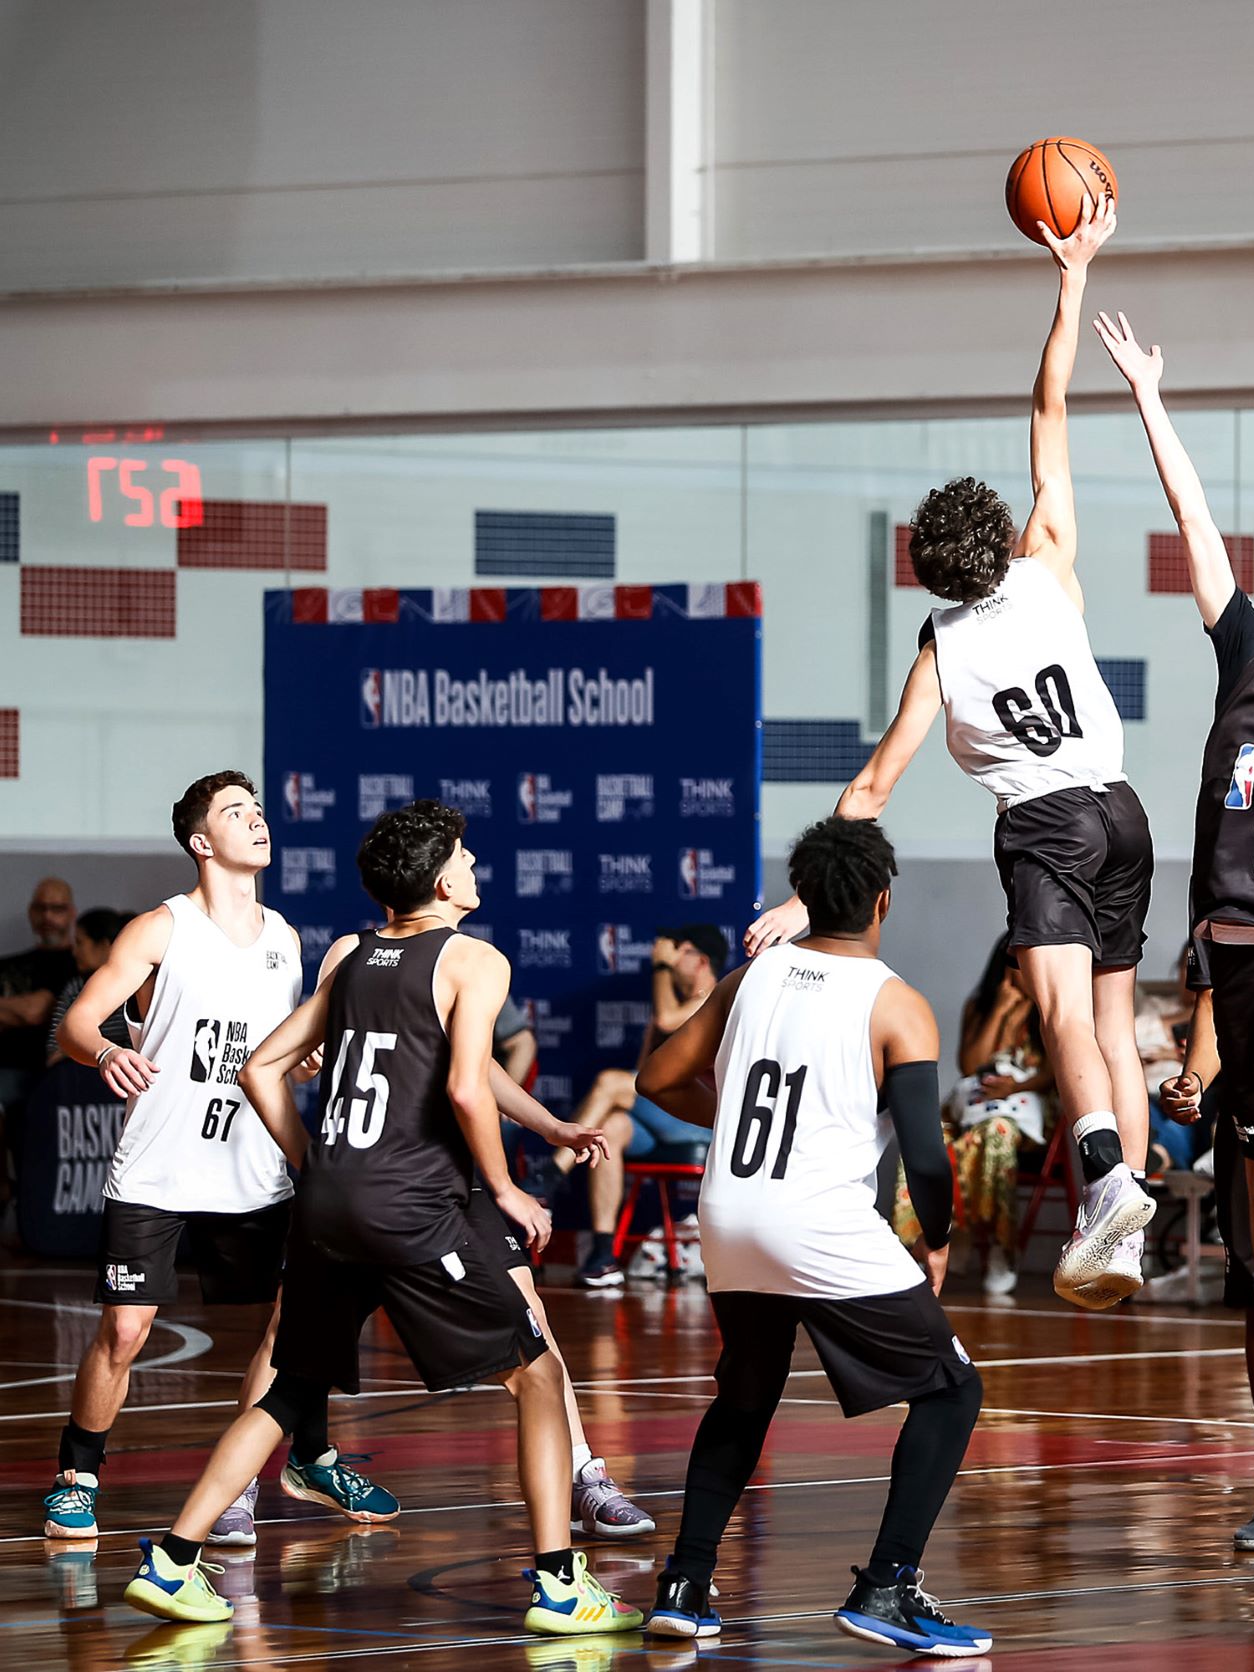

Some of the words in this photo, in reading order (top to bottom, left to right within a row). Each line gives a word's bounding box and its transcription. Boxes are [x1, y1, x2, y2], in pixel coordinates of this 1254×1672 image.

[972, 594, 1008, 615] THINK
[384, 669, 430, 727] NBA
[434, 668, 564, 727] Basketball
[568, 667, 654, 727] School
[992, 663, 1083, 757] 60
[438, 779, 491, 798] THINK
[680, 778, 734, 799] THINK
[598, 854, 652, 874] THINK
[519, 929, 571, 949] THINK
[366, 957, 400, 967] SPORTS
[373, 948, 405, 959] THINK
[781, 978, 823, 992] SPORTS
[788, 966, 830, 982] THINK
[226, 1021, 248, 1043] NBA
[222, 1043, 253, 1066] Bask
[216, 1064, 242, 1086] Sch
[321, 1029, 397, 1149] 45
[201, 1098, 241, 1142] 67
[730, 1058, 808, 1179] 61
[57, 1104, 127, 1159] BASKE
[54, 1161, 113, 1214] CAM
